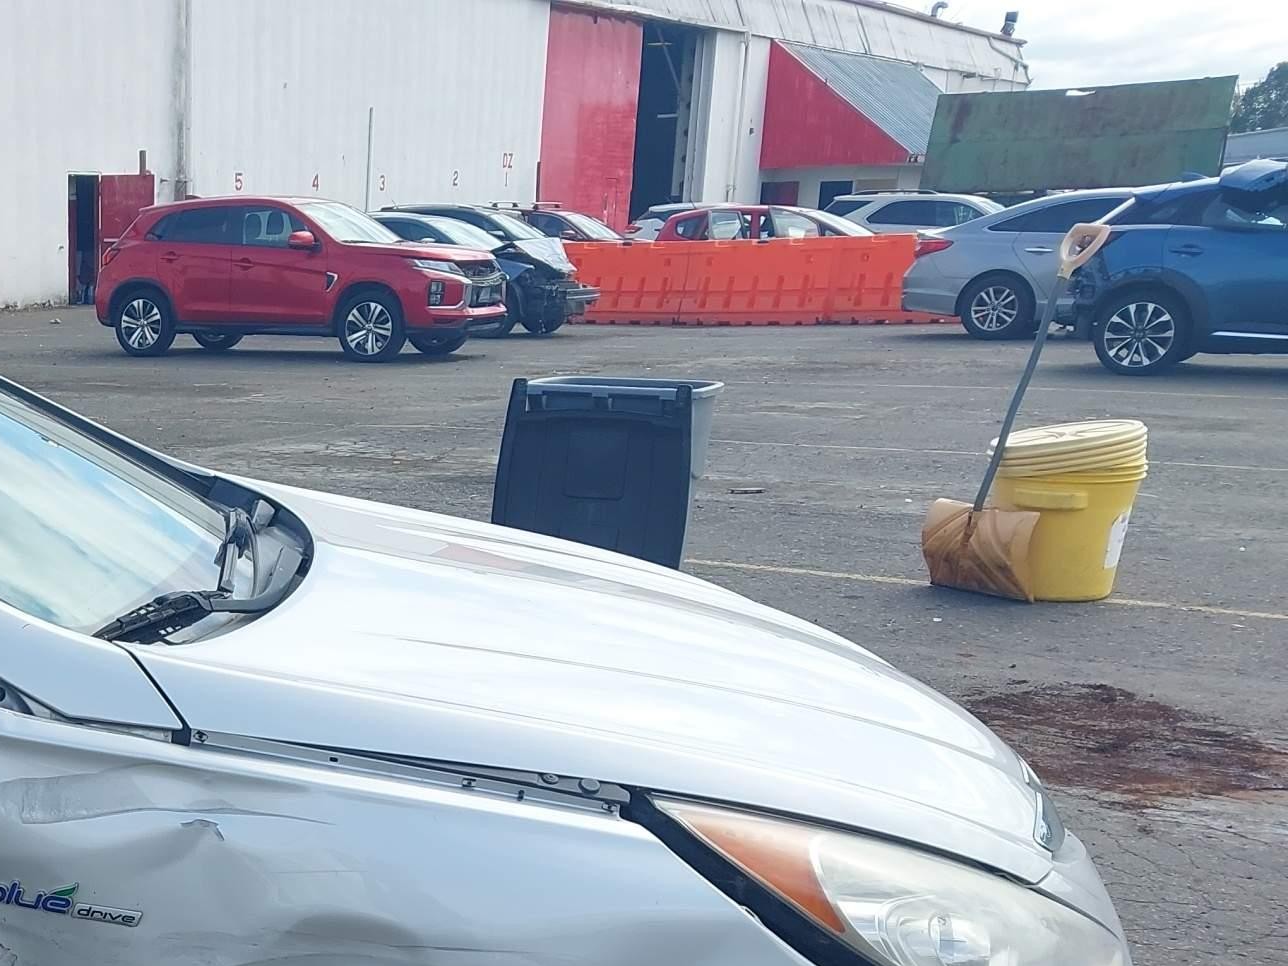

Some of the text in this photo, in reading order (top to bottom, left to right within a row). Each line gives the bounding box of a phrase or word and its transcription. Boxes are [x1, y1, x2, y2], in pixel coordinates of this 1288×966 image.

[502, 152, 514, 169] DZ
[234, 172, 244, 191] 5
[311, 173, 320, 192] 4
[378, 174, 386, 192] 3
[452, 170, 460, 187] 2
[76, 906, 136, 924] drive
